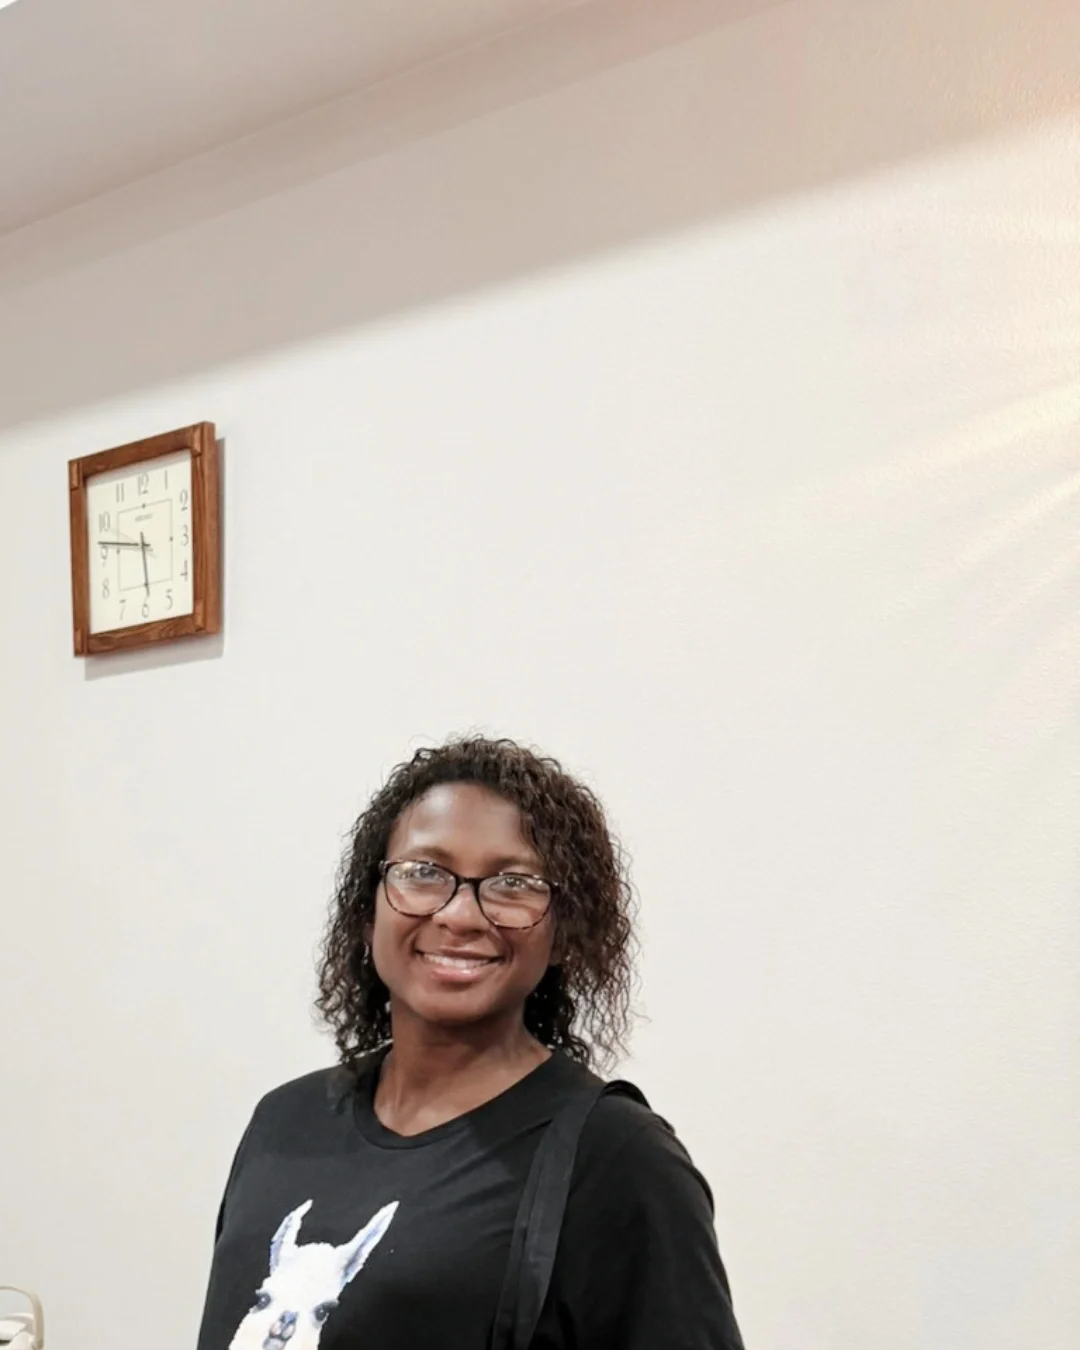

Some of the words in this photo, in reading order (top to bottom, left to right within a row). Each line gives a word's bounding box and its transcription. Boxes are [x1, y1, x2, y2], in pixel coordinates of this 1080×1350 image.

[115, 483, 125, 502] 11
[138, 472, 149, 496] 12
[179, 489, 189, 511] 2
[99, 511, 111, 533] 10
[180, 524, 189, 546] 3
[179, 560, 189, 581] 4
[102, 578, 110, 599] 8
[165, 588, 174, 611] 5
[119, 599, 127, 621] 7
